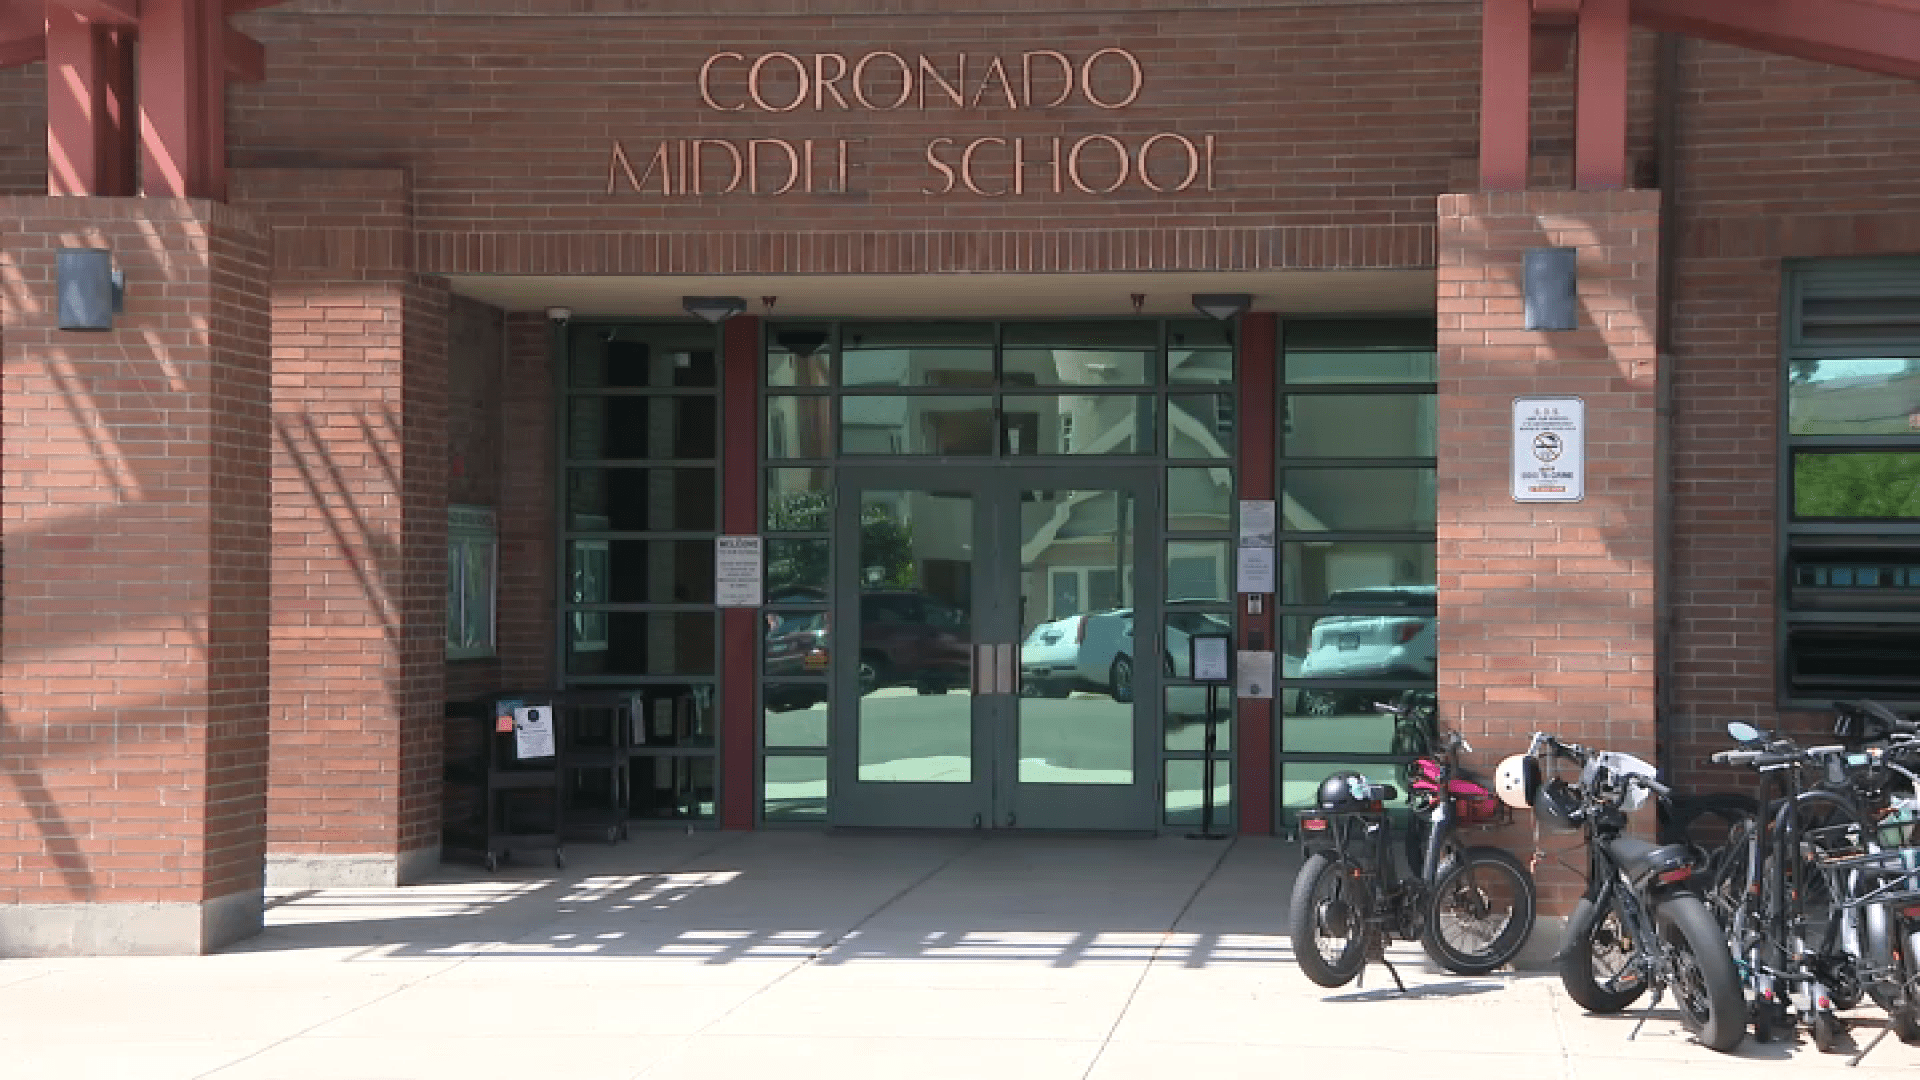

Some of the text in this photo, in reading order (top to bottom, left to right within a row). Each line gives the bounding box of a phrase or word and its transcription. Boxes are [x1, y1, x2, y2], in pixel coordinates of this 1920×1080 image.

[699, 48, 1143, 112] CORONADO
[607, 133, 1218, 196] MIDDLE SCHOOL
